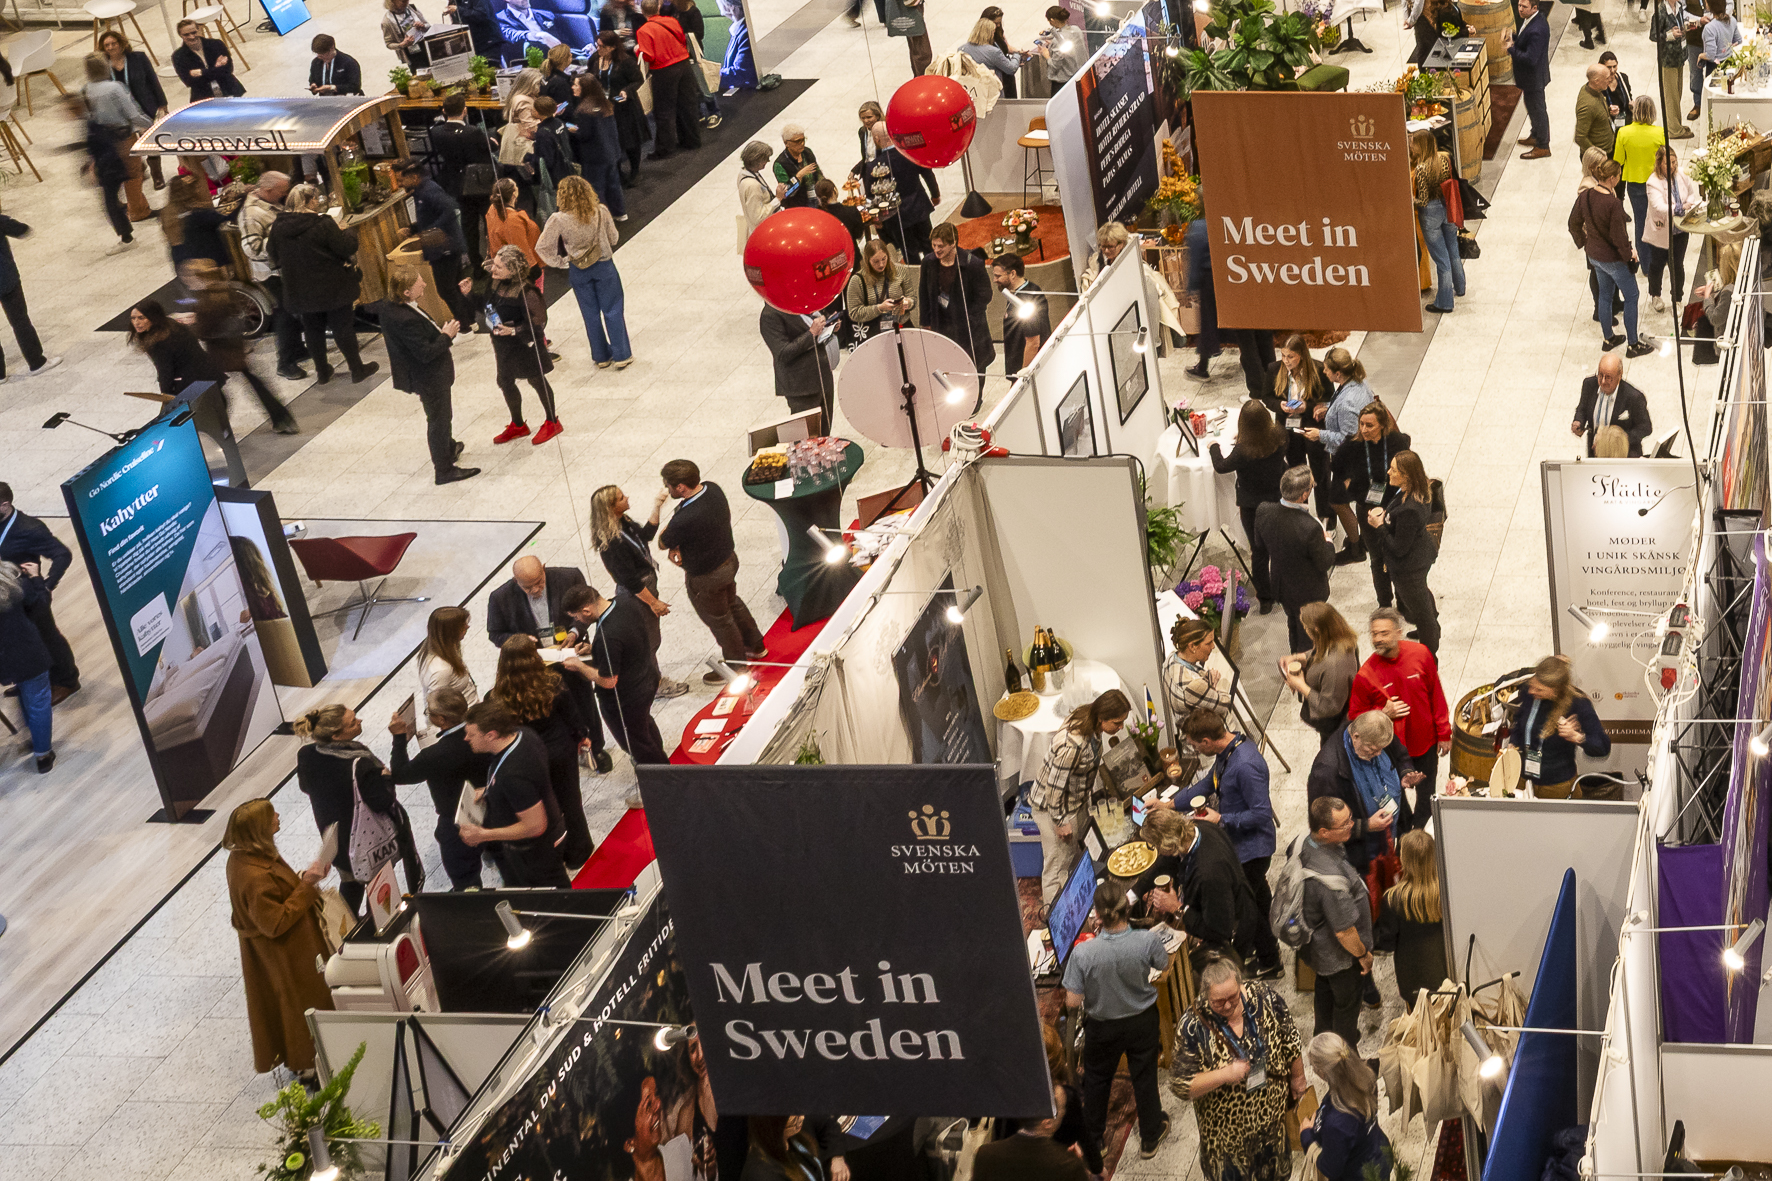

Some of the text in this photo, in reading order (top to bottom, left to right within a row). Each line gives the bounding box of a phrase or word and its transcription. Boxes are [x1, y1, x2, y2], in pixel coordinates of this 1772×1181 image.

[154, 130, 290, 152] Comwell
[1337, 141, 1391, 150] SVENSKA
[1344, 151, 1387, 162] MÖTEN
[1221, 216, 1358, 247] Meet in
[1226, 254, 1371, 286] Sweden
[89, 447, 155, 499] Go Nordic Cruiseline
[99, 484, 160, 537] Kahytter
[1609, 537, 1656, 546] MØDER
[1587, 550, 1680, 560] I UNIK SKÅNSK
[1582, 565, 1686, 575] VINGÅRDSMILJØ
[1591, 589, 1636, 598] Konference,
[1587, 599, 1668, 609] hotel, fest og bryllup
[372, 839, 397, 864] KAN
[891, 844, 981, 857] SVENSKA
[904, 859, 974, 874] MÖTEN
[709, 960, 941, 1004] Meet in
[540, 1083, 556, 1110] DU
[558, 1046, 581, 1082] SUD
[583, 1033, 593, 1047] &
[593, 976, 637, 1033] HOTELL
[637, 918, 674, 974] FRITIDE
[725, 1019, 965, 1061] Sweden
